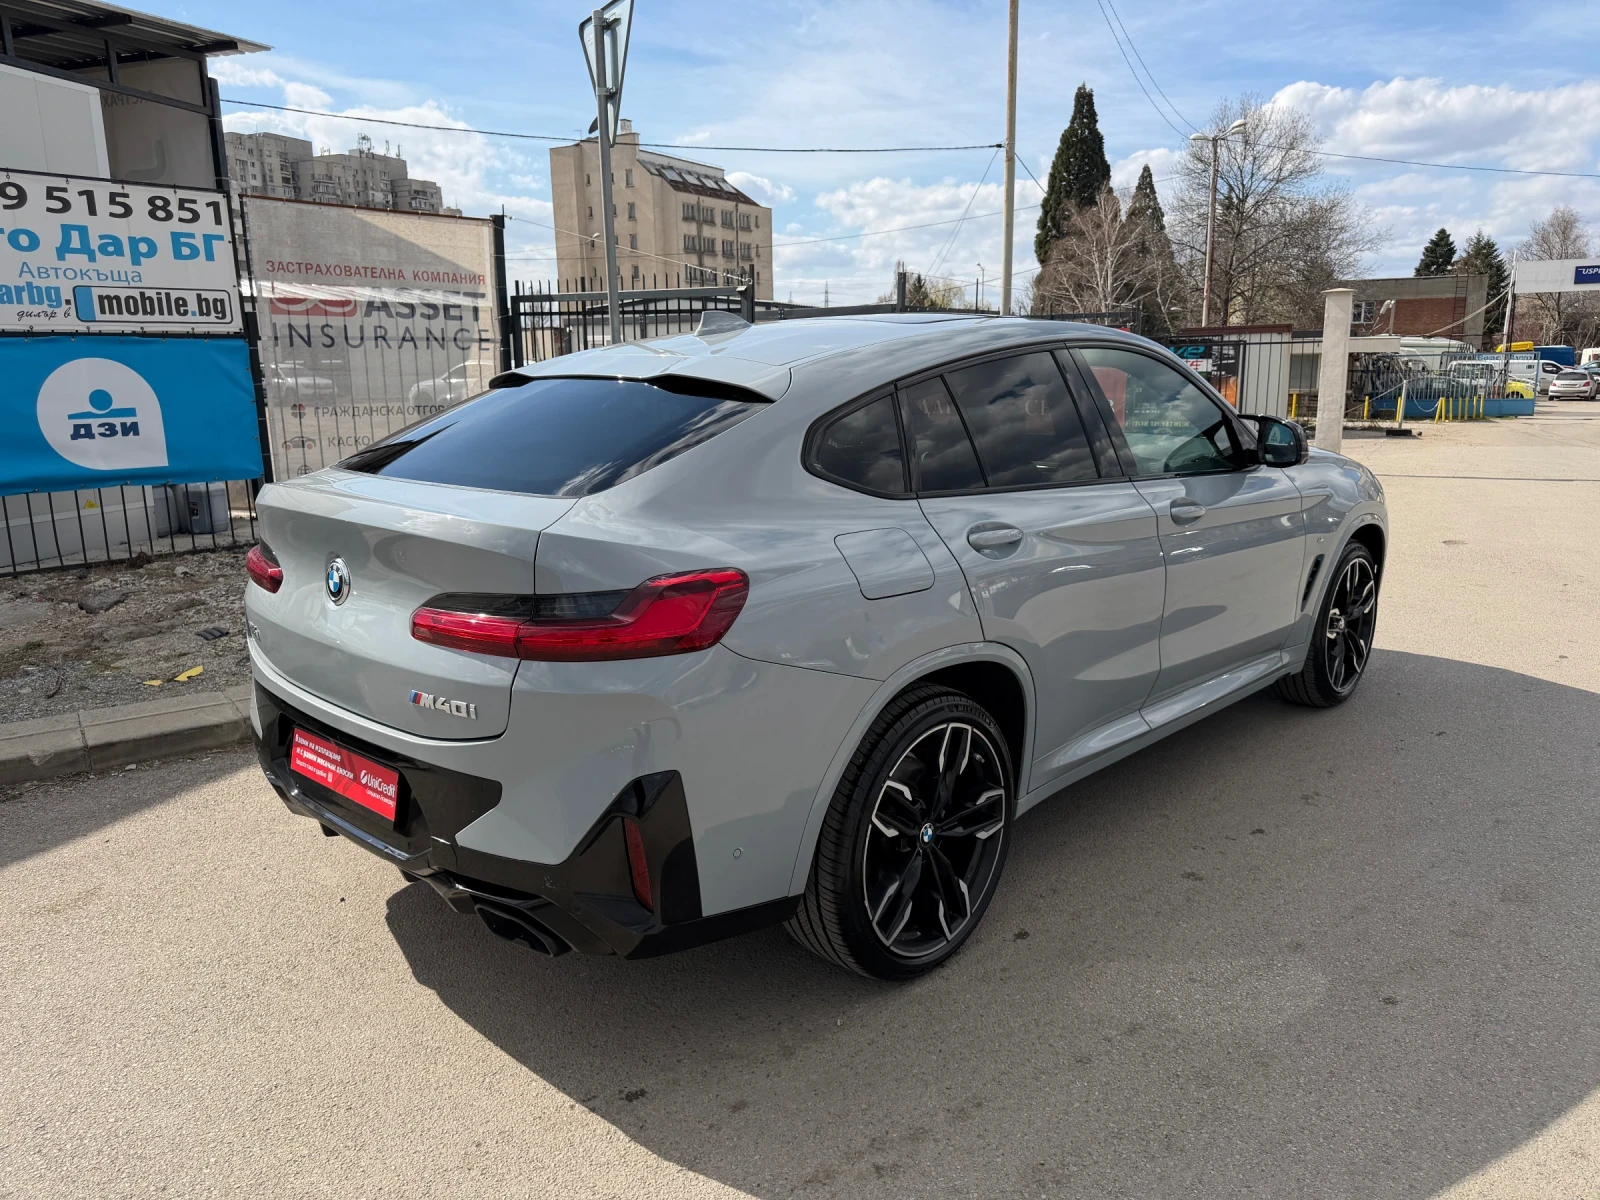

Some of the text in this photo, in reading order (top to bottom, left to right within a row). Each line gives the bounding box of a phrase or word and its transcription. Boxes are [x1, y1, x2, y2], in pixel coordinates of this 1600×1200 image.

[45, 186, 133, 219] 515
[147, 195, 223, 226] 851
[55, 223, 158, 266] Дар
[170, 231, 225, 262] БГ
[18, 261, 143, 285] Автокъща
[265, 260, 486, 285] ЗАСТРАХОВАТЕЛНА КОМПАНИЯ
[98, 290, 227, 320] mobile.bg
[363, 286, 486, 322] ASSET
[272, 321, 491, 351] INSURANCE
[314, 404, 404, 419] ГРАЖДАНСКА
[70, 421, 140, 441] ДЗИ
[327, 435, 371, 448] КАСКО
[420, 692, 478, 720] M40i
[367, 773, 395, 798] UniCredit
